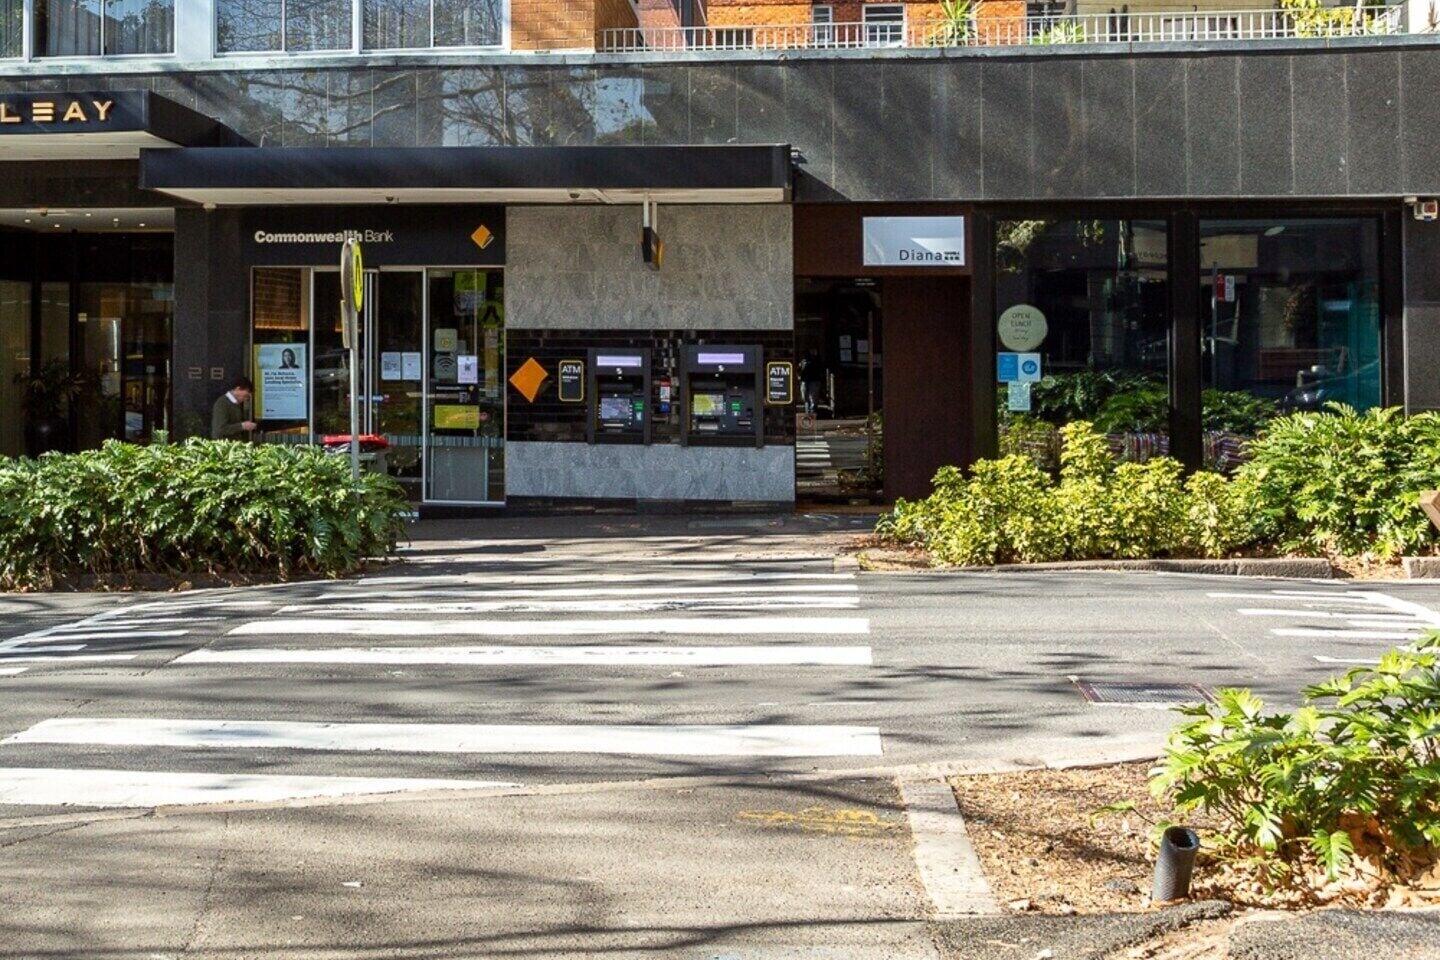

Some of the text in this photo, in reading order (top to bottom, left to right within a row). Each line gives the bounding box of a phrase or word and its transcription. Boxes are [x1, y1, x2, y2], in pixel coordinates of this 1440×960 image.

[254, 229, 394, 243] Commonwealth Bank
[899, 249, 943, 261] Diana
[561, 365, 581, 374] ATM
[770, 367, 790, 376] ATM
